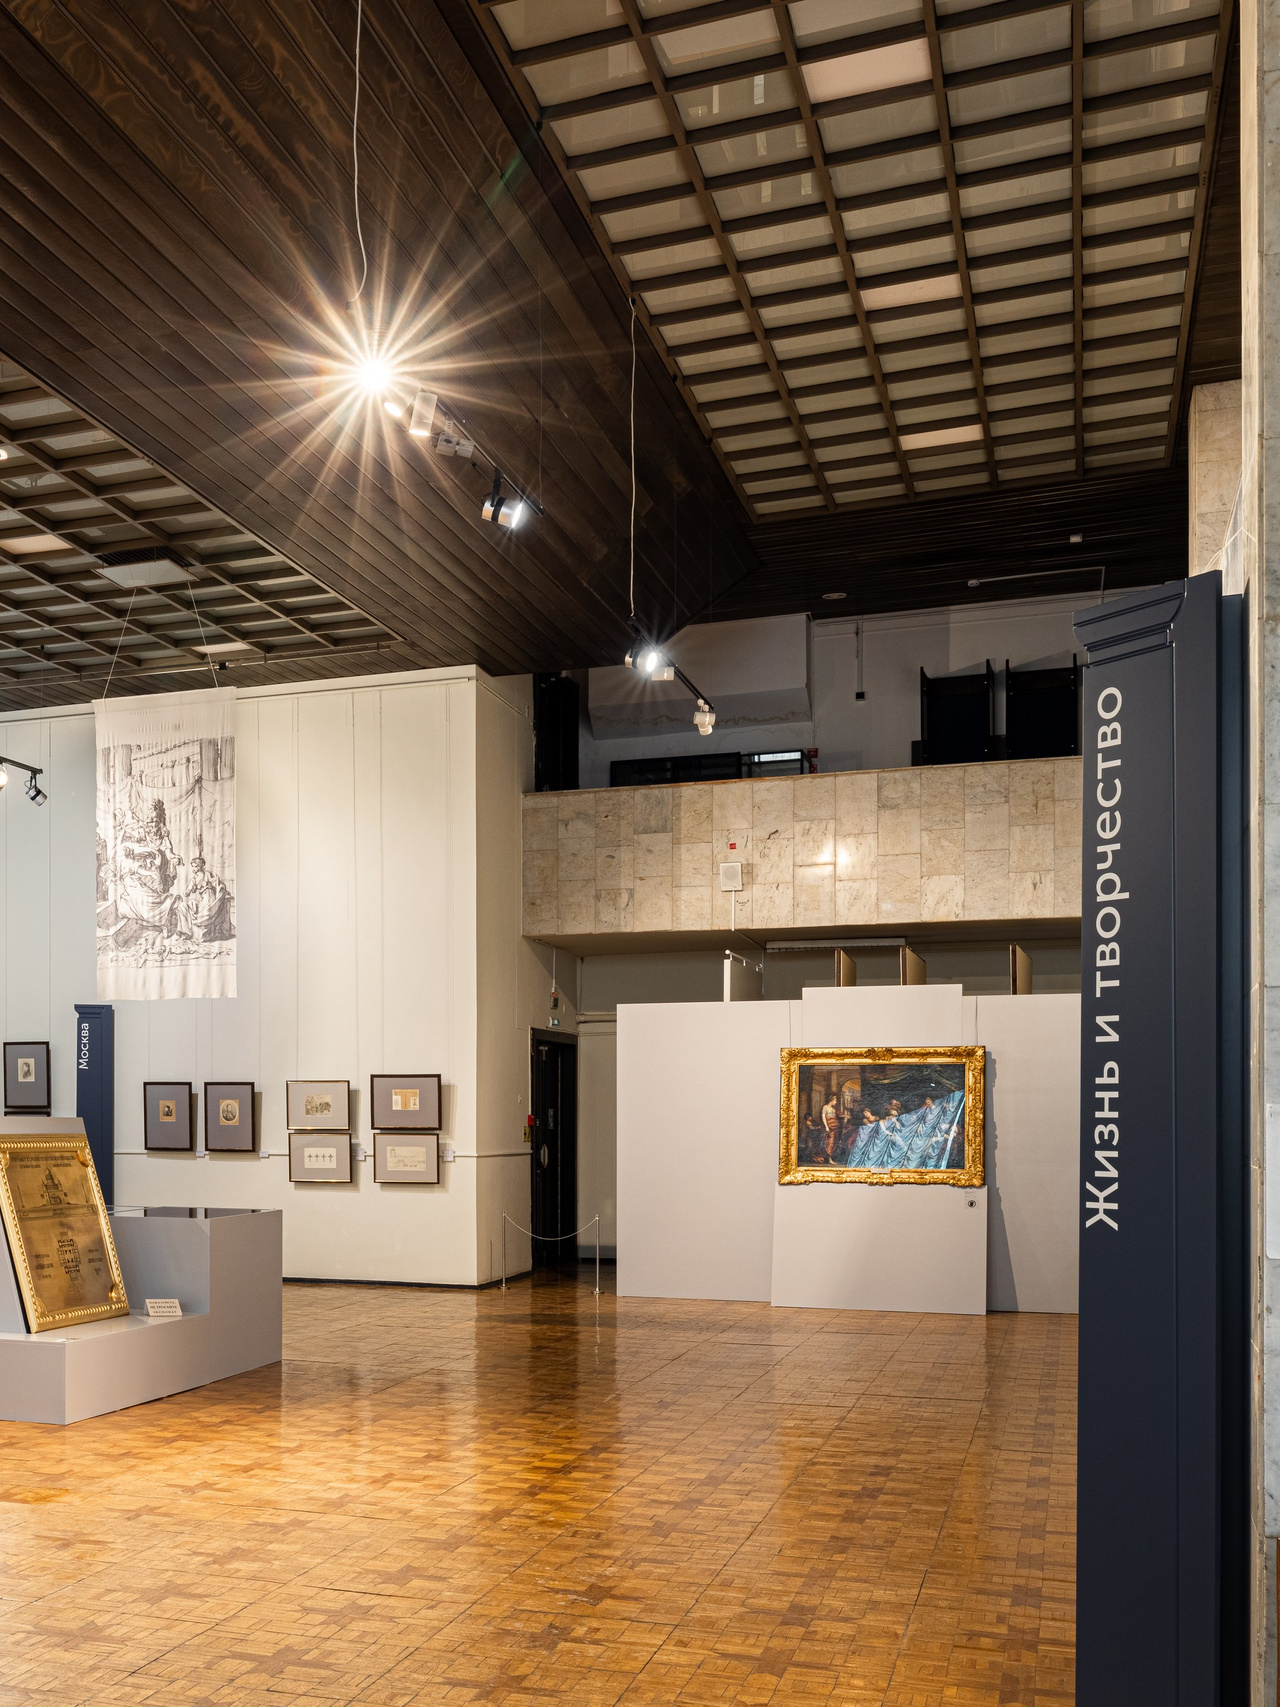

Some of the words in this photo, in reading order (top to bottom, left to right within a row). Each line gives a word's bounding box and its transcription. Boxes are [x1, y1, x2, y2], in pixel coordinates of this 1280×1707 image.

[1094, 686, 1129, 997] творчество
[78, 1023, 89, 1069] Москва
[1095, 1014, 1120, 1042] и
[1085, 1060, 1120, 1231] Жизнь
